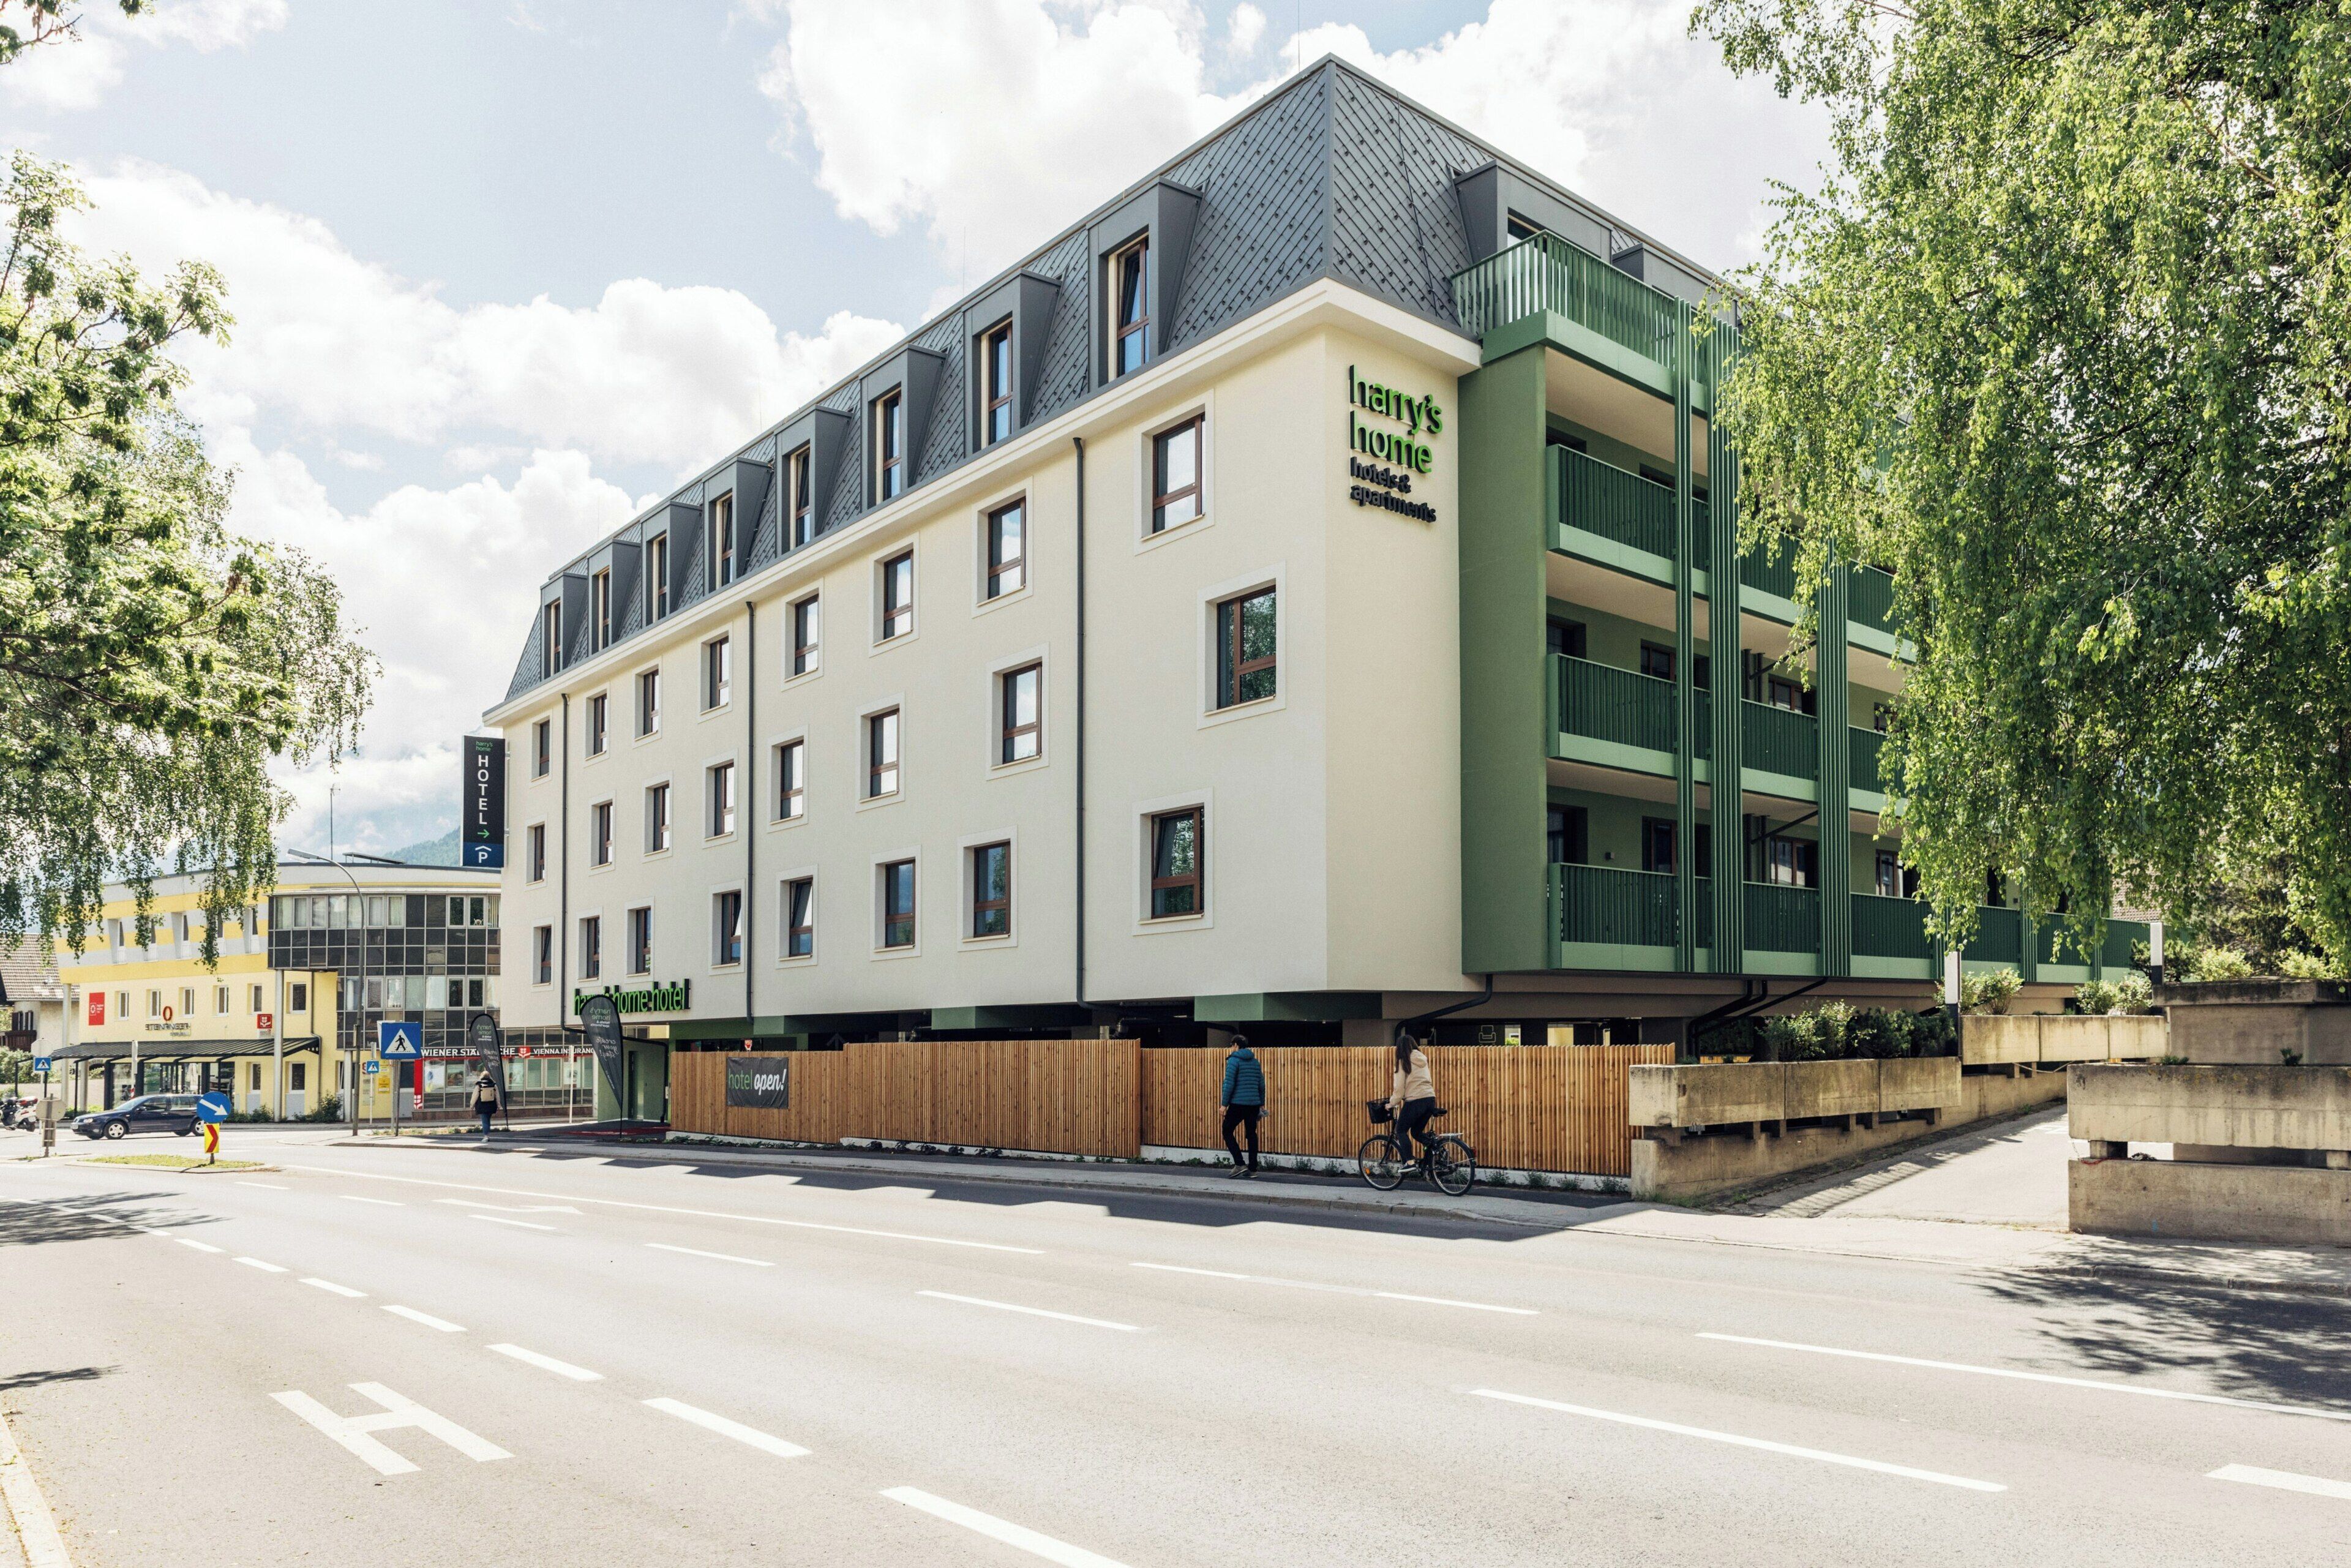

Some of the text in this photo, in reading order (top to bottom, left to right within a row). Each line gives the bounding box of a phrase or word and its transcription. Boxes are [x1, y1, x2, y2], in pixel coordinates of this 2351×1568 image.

[1349, 364, 1442, 435] harry's
[1349, 410, 1433, 473] home
[1350, 456, 1411, 493] hotels &
[1350, 485, 1436, 523] apartments
[478, 754, 489, 825] HOTEL
[613, 985, 651, 1013] home
[651, 978, 691, 1011] hotel
[421, 1048, 458, 1057] WIENER
[728, 1068, 787, 1096] hotel open!
